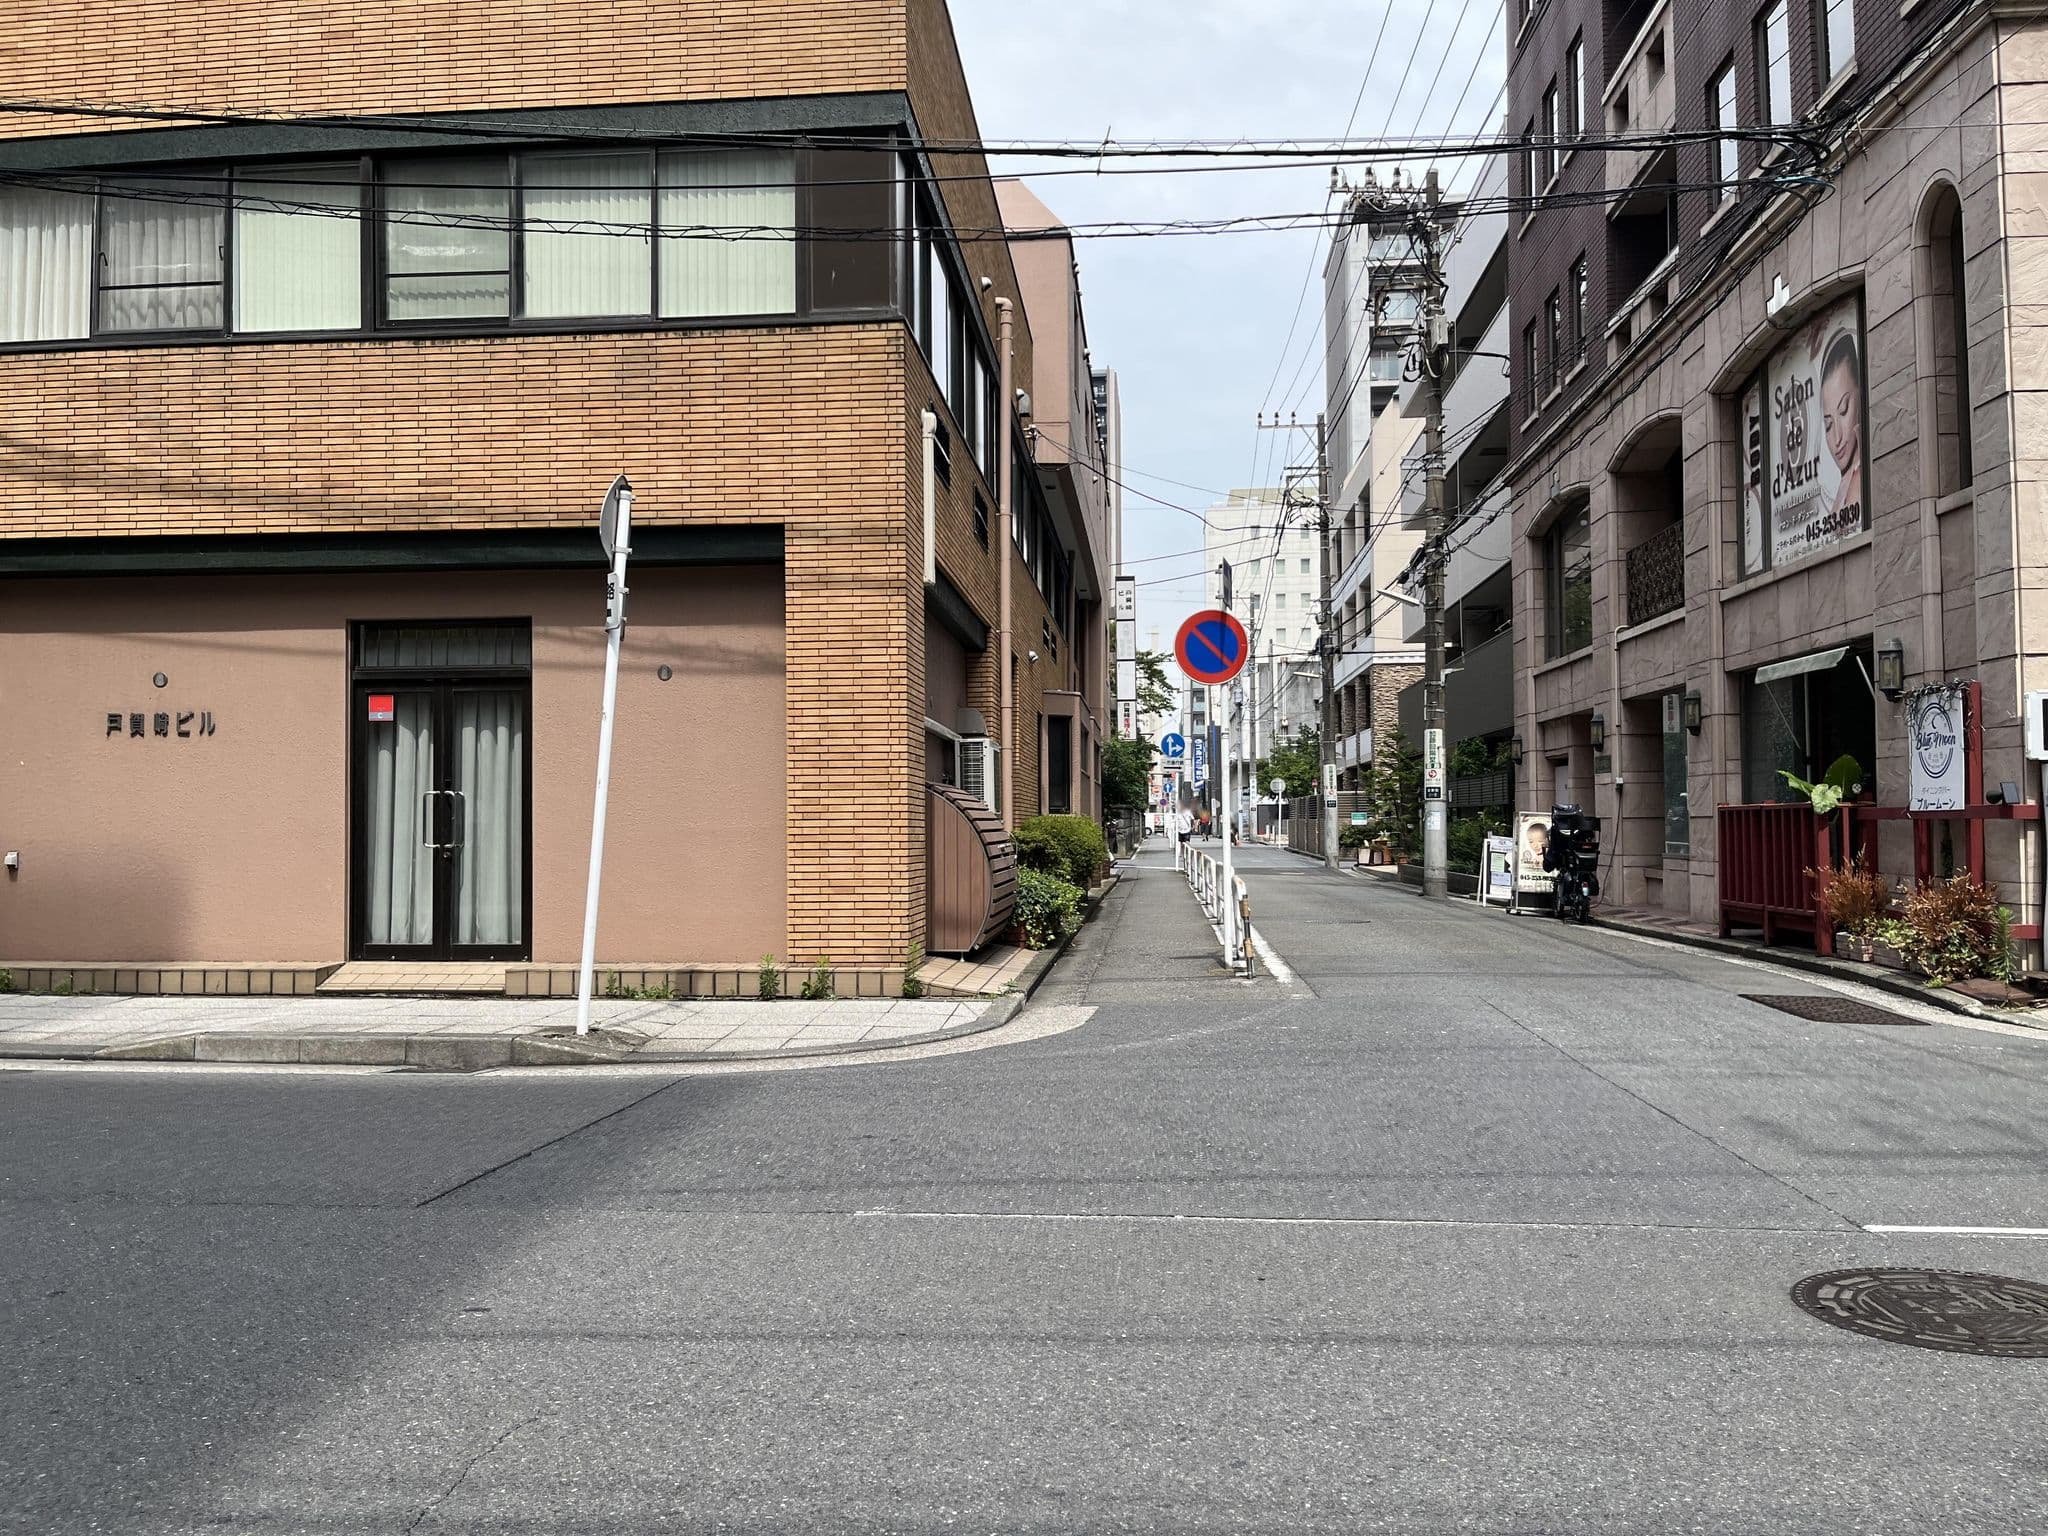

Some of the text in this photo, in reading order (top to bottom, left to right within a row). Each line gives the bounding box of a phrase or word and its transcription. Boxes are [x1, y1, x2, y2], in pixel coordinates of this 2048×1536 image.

[1774, 374, 1814, 420] Salon
[1787, 416, 1803, 452] de
[1772, 455, 1820, 499] d'Azur
[1806, 502, 1860, 542] 045-253-8030
[1915, 731, 1956, 750] Blue Moon
